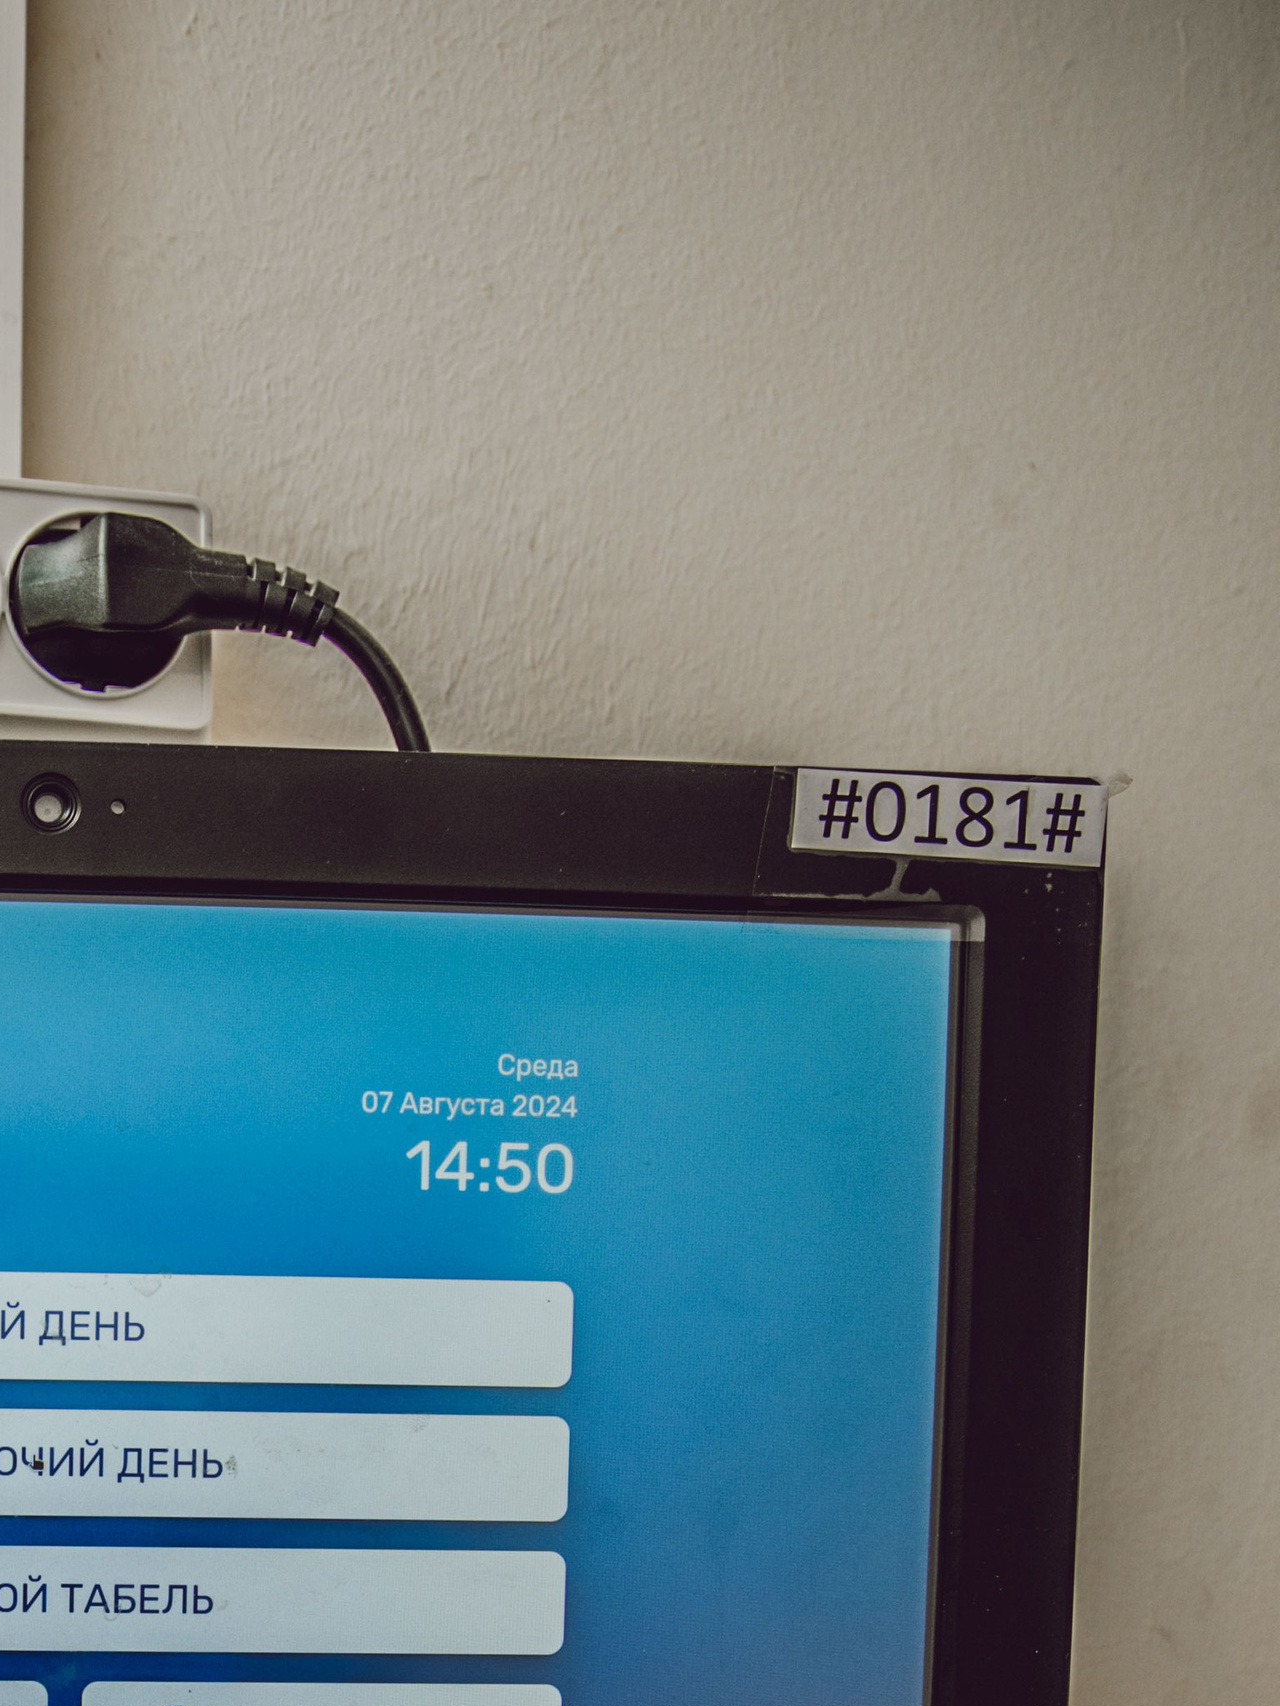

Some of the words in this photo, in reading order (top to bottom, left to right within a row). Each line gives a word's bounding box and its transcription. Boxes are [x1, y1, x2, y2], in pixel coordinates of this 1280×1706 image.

[819, 778, 1086, 853] #0181#
[497, 1053, 579, 1081] Среда
[361, 1090, 394, 1115] 07
[399, 1091, 505, 1121] Августа
[511, 1094, 578, 1118] 2024
[405, 1140, 574, 1194] 14:50
[38, 1310, 146, 1346] ДЕНЬ
[117, 1447, 224, 1483] ДЕНЬ
[60, 1583, 215, 1615] ТАБЕЛЬ
